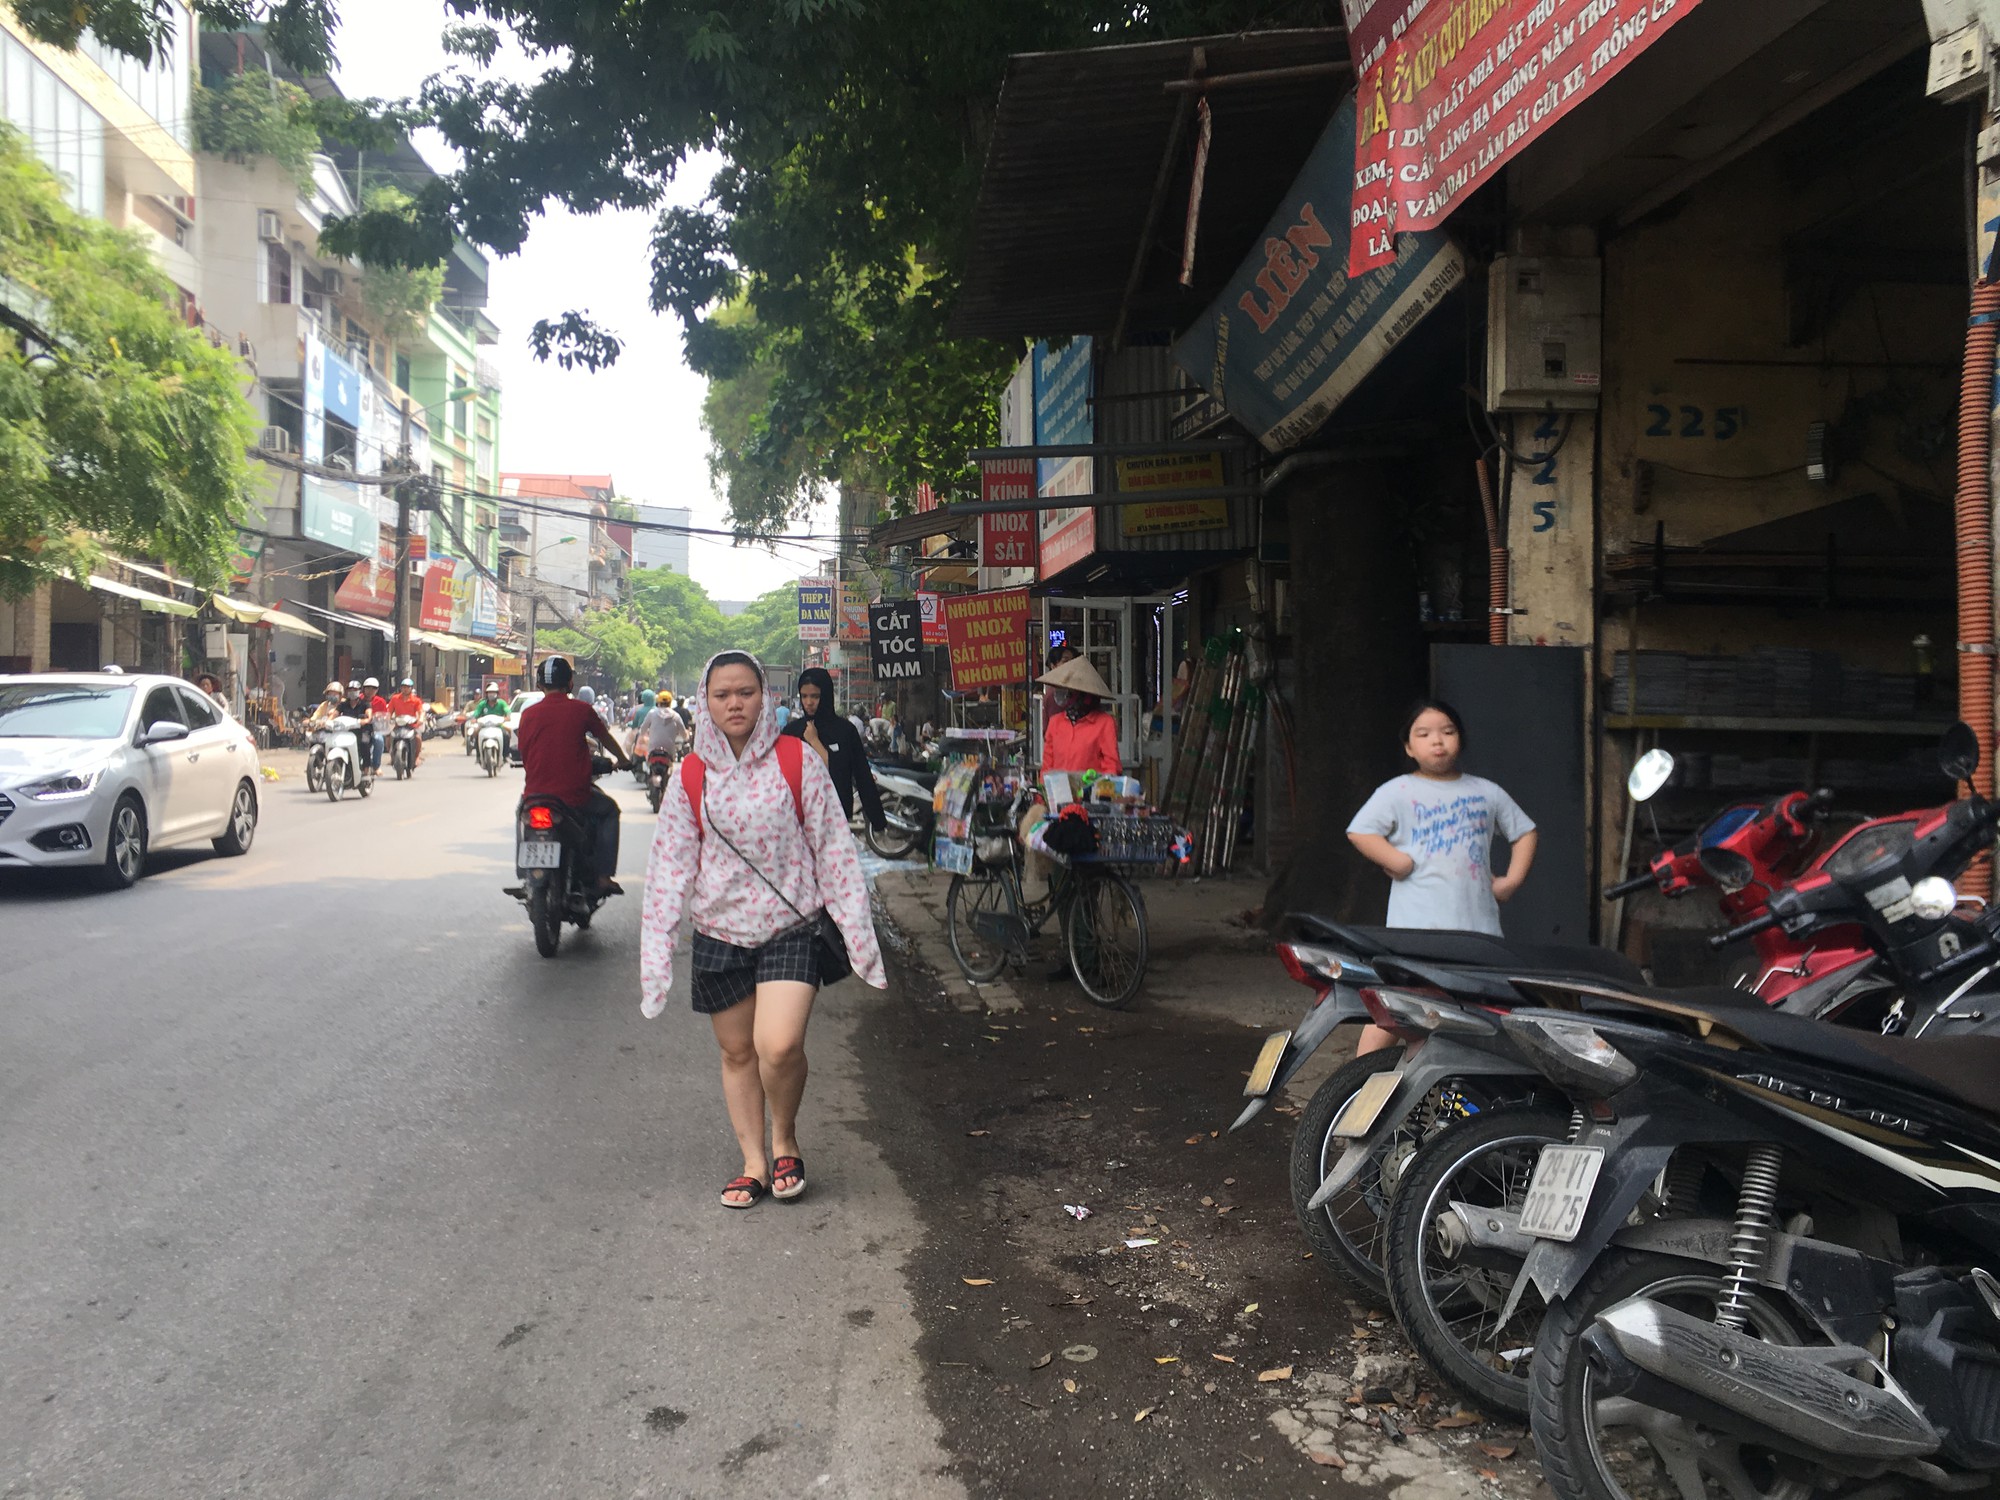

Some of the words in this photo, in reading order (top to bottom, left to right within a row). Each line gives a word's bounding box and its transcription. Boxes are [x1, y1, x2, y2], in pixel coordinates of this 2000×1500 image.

[1492, 67, 1538, 116] KHÔNG
[1355, 159, 1387, 191] XEM
[1426, 103, 1442, 132] ÁN
[1443, 77, 1466, 118] LẤY
[1468, 47, 1494, 95] NHÀ
[1496, 24, 1525, 67] MẶT
[1368, 229, 1392, 257] LÀ
[1478, 136, 1505, 172] LÀM
[1562, 62, 1586, 101] XE,
[1238, 202, 1333, 334] LIÊN
[1646, 404, 1741, 441] 225
[990, 480, 1029, 501] KÍNH
[990, 513, 1028, 532] INOX
[994, 535, 1025, 561] SẮT
[801, 589, 823, 604] THÉP
[947, 598, 990, 620] NHÔM
[993, 594, 1027, 614] KÍNH
[801, 609, 814, 620] ĐA
[876, 609, 911, 631] CẮT
[966, 617, 1014, 639] INOX
[879, 635, 916, 654] TÓC
[952, 641, 979, 665] SẮT,
[981, 640, 1006, 661] MÁI
[878, 661, 922, 679] NAM
[957, 663, 1008, 685] NHÔM
